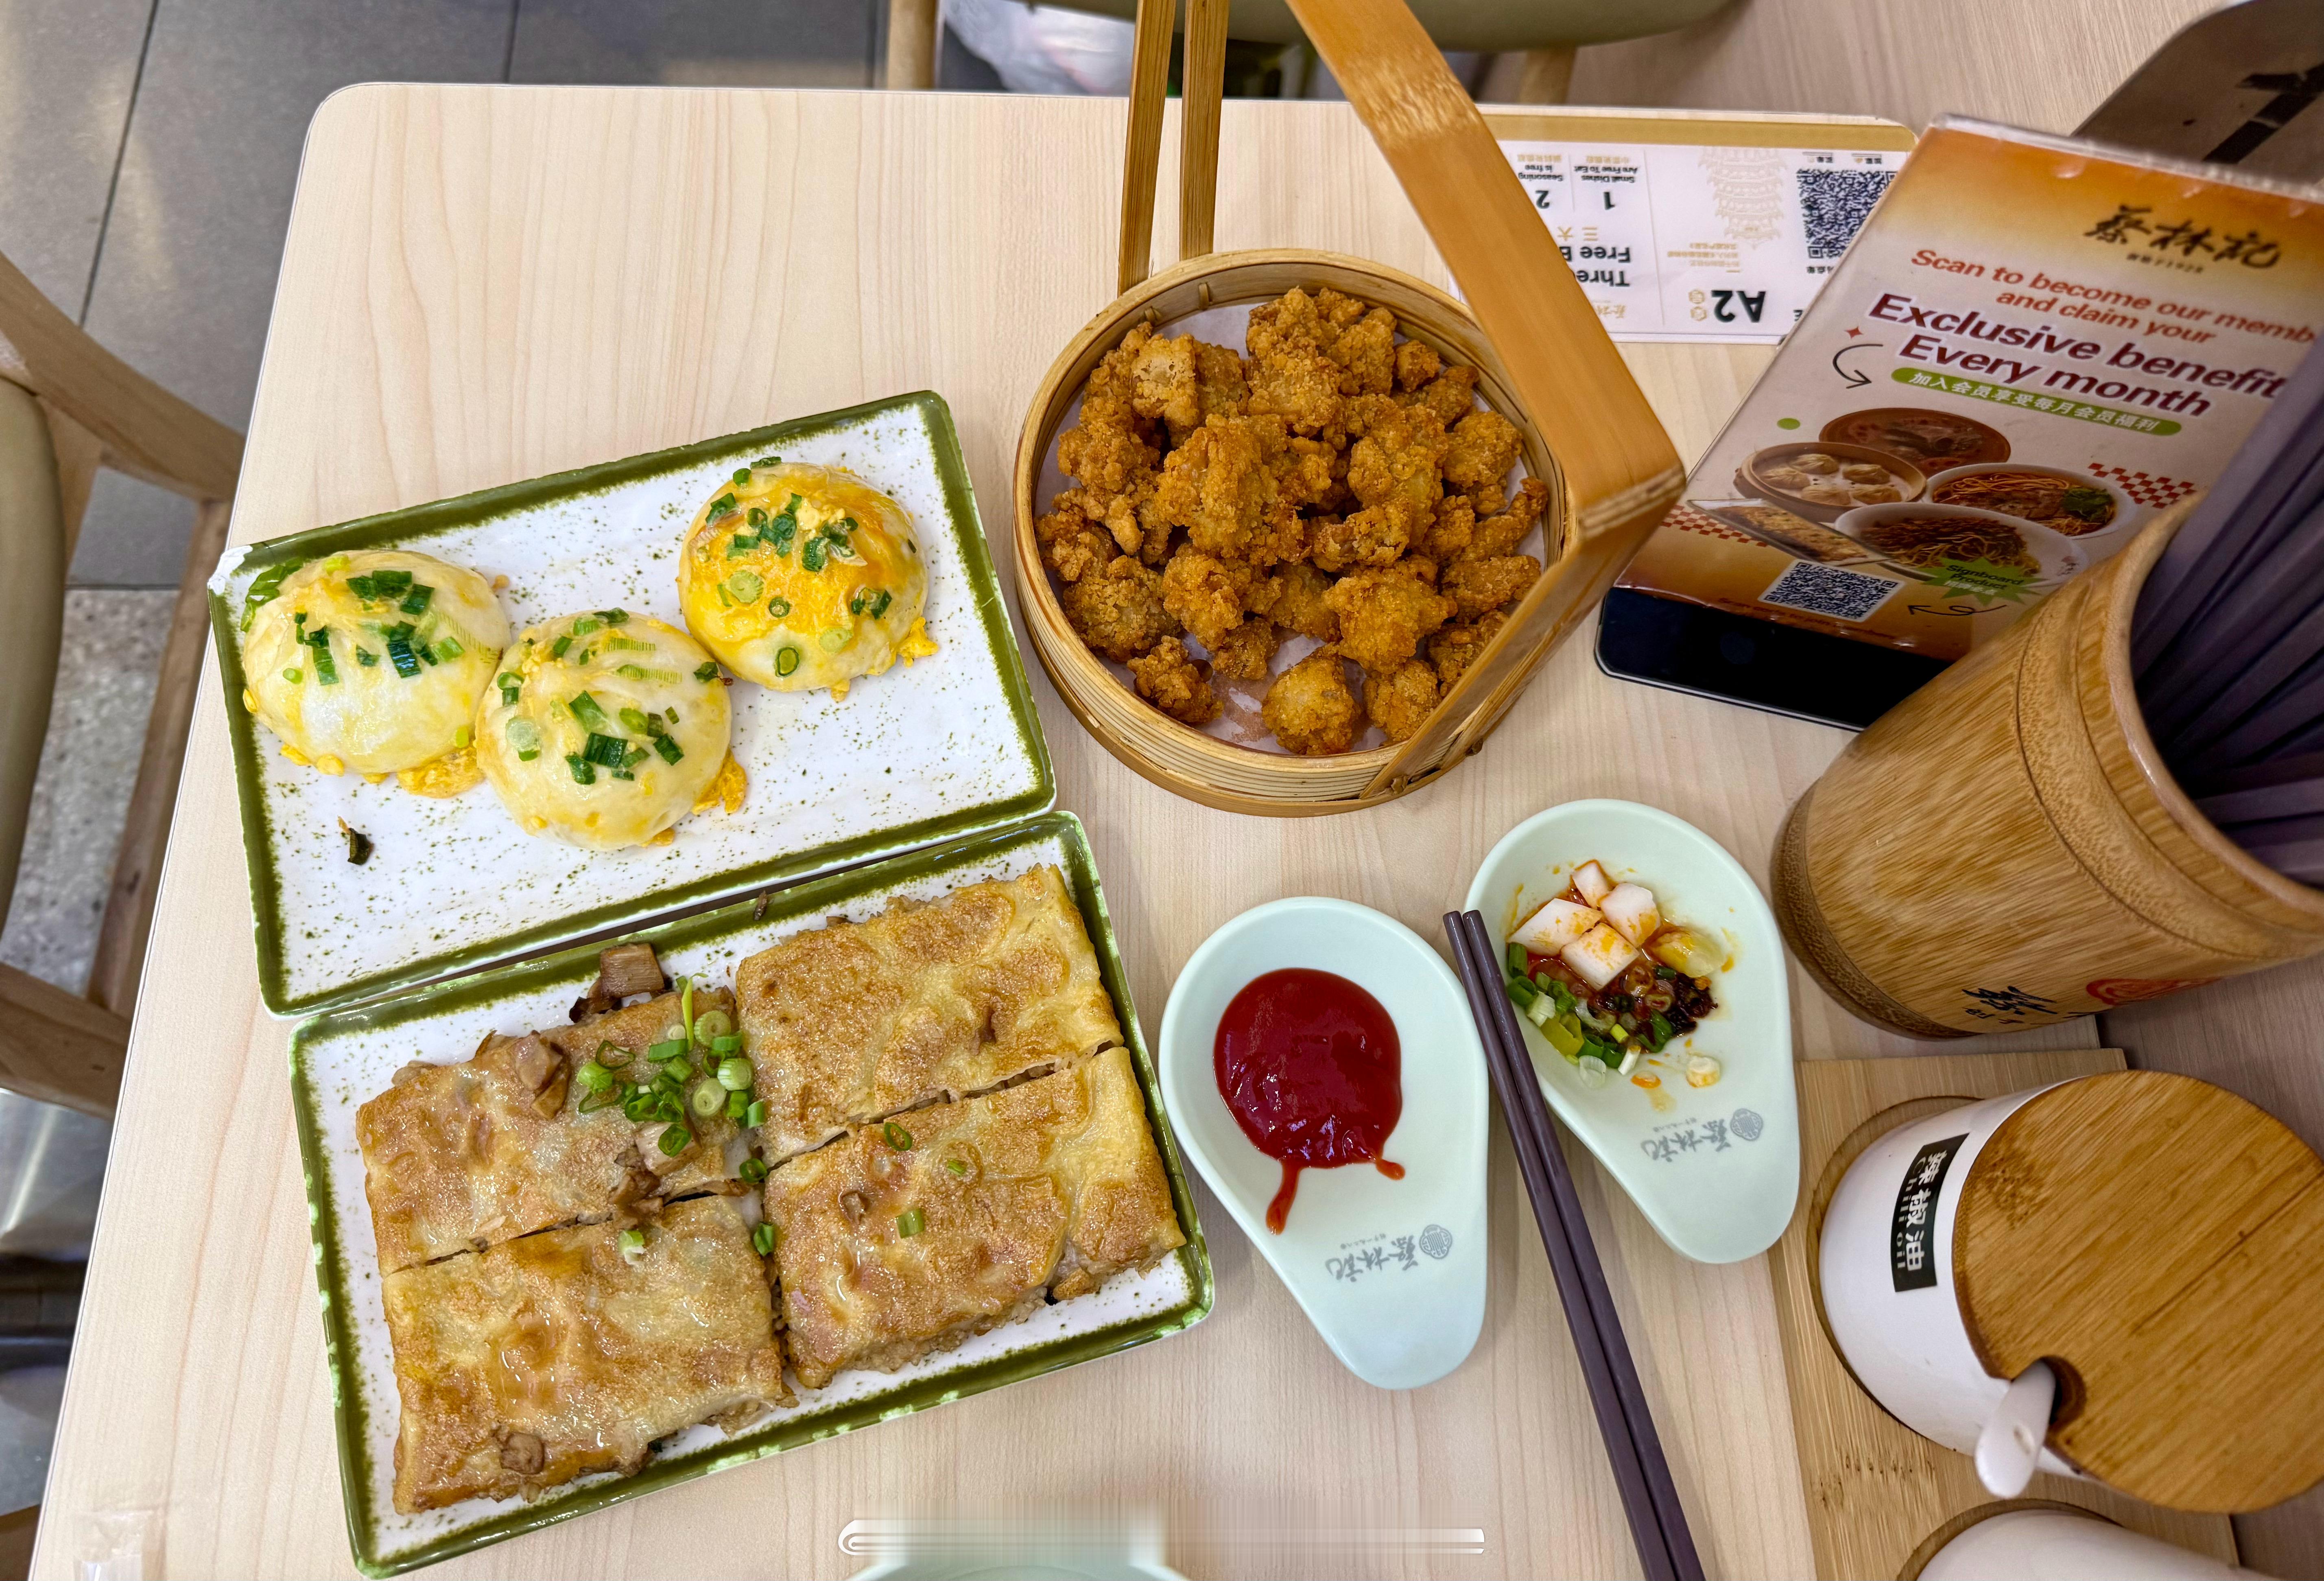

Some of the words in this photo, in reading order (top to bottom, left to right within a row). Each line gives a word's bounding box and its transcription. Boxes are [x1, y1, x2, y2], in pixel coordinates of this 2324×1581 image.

[1518, 173, 1563, 181] Seasoning
[1535, 190, 1550, 210] 2
[1603, 192, 1615, 210] 1
[1580, 247, 1631, 263] Free
[1911, 249, 1985, 277] Scan
[1992, 266, 2024, 284] to
[2029, 271, 2151, 311] become
[2157, 303, 2212, 321] our
[1711, 291, 1766, 323] A2
[1996, 292, 2055, 312] and
[2058, 303, 2139, 329] claim
[2144, 321, 2216, 344] your
[1869, 292, 2101, 361] Exclusive
[1899, 334, 2039, 384] Every
[2045, 369, 2212, 418] month
[1909, 372, 2160, 431] 加入会员享受每月会员福利
[1946, 564, 2025, 585] Signboard
[1951, 573, 2007, 590] Product
[1898, 1156, 1926, 1222] Chili
[1906, 1150, 1947, 1271] 辣椒油
[1896, 1234, 1906, 1269] oil
